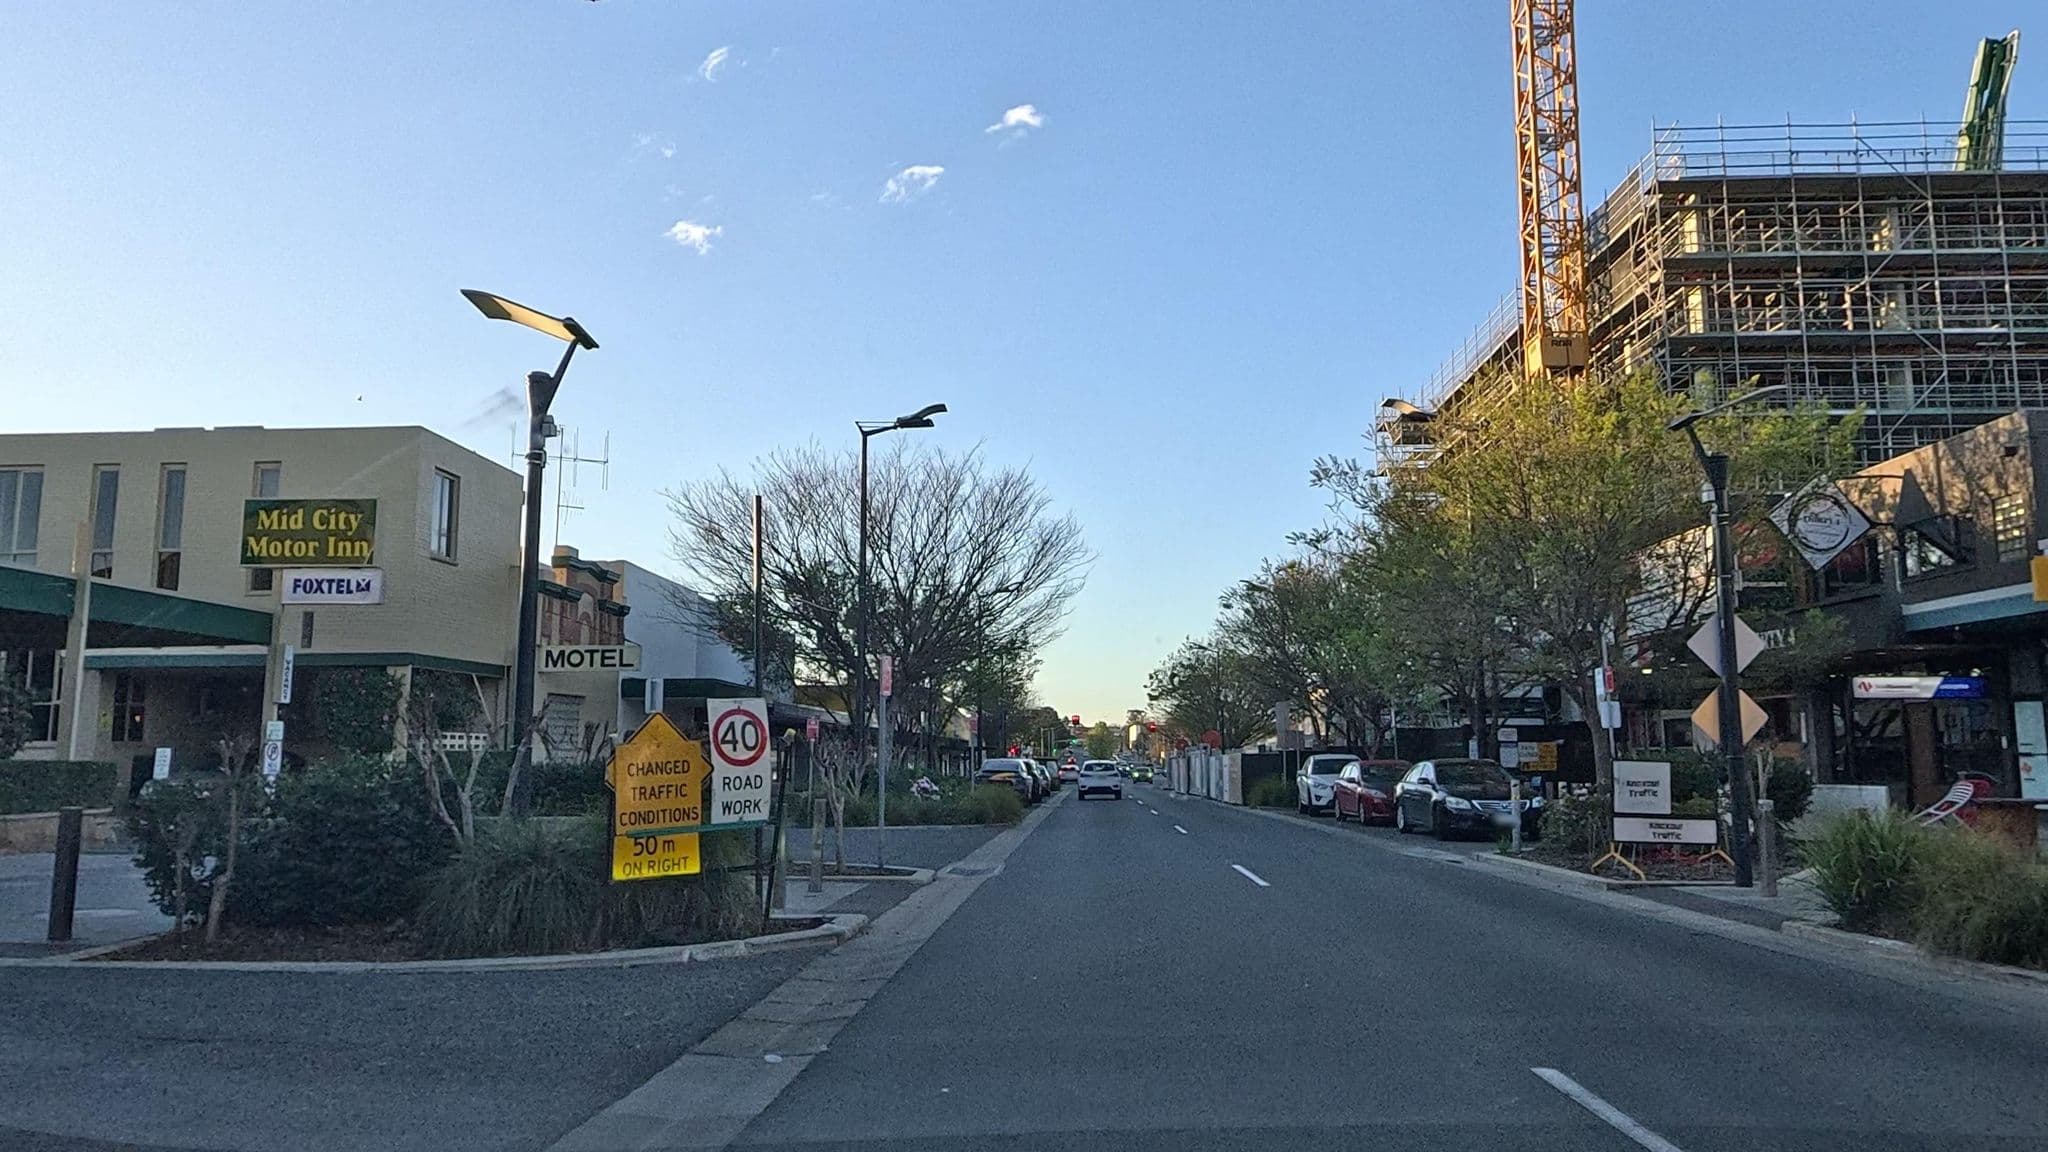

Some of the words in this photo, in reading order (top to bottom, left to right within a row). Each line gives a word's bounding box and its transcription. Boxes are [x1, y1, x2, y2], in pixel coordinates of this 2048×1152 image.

[256, 508, 304, 530] Mid
[312, 507, 363, 536] City
[246, 536, 320, 557] Motor
[326, 536, 370, 557] Inn
[292, 578, 354, 594] FOXTEL
[544, 648, 635, 668] MOTEL
[719, 719, 760, 752] 40
[627, 759, 691, 777] CHANGED
[631, 783, 688, 801] TRAFFIC
[722, 774, 763, 791] ROAD
[1628, 789, 1659, 798] Traffic
[619, 806, 699, 827] CONDITIONS
[721, 799, 762, 816] WORK
[1651, 831, 1683, 840] Traffic
[633, 835, 658, 857] 50
[662, 838, 675, 850] m
[622, 861, 643, 876] ON
[647, 856, 690, 874] RIGHT
